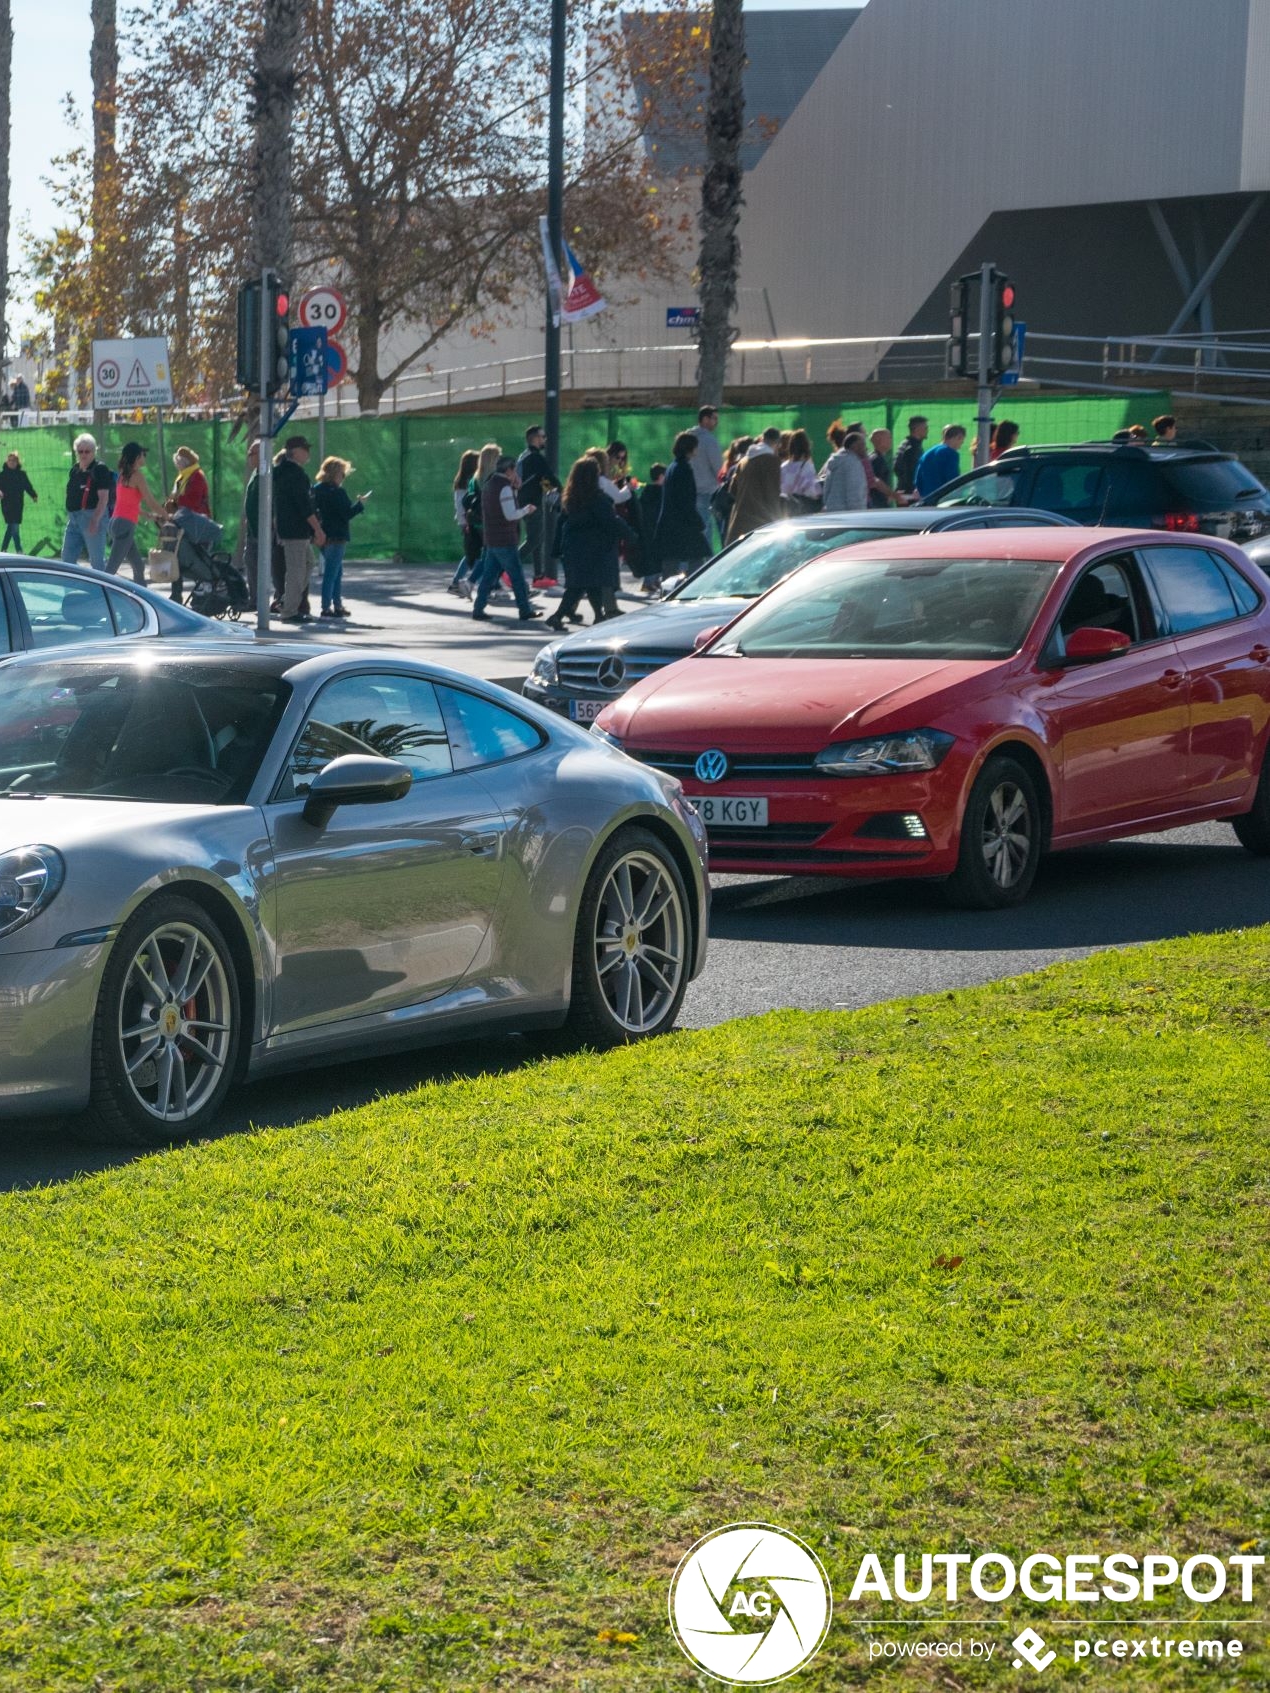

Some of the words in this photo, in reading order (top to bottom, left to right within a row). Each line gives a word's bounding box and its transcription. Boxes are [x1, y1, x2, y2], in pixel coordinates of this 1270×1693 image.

[310, 304, 337, 320] 30
[101, 368, 116, 380] 30
[722, 800, 759, 821] KGY
